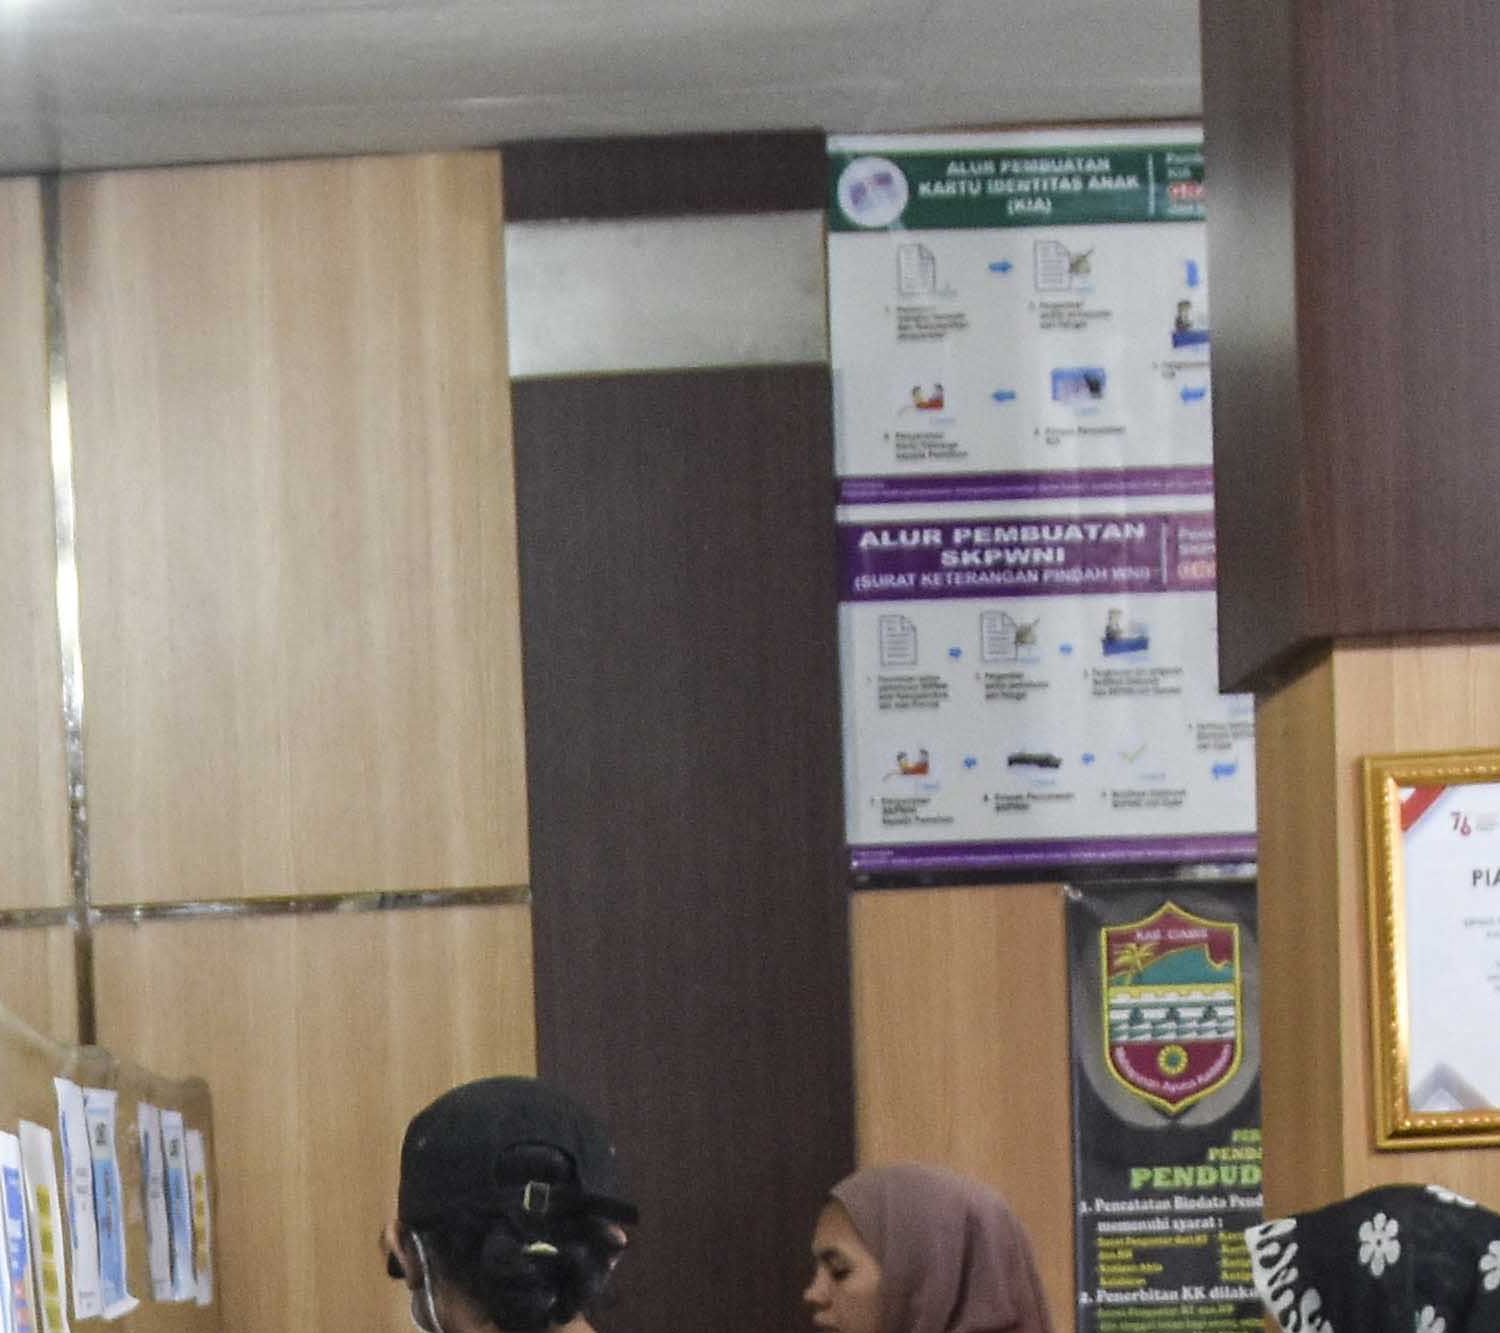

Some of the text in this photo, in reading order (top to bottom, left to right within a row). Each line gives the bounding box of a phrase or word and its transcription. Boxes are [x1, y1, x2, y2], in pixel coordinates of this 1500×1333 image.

[859, 523, 1145, 548] ALUR PEMBUATAN
[940, 547, 1065, 567] SKPWNI
[921, 569, 1038, 586] KETERANGAN
